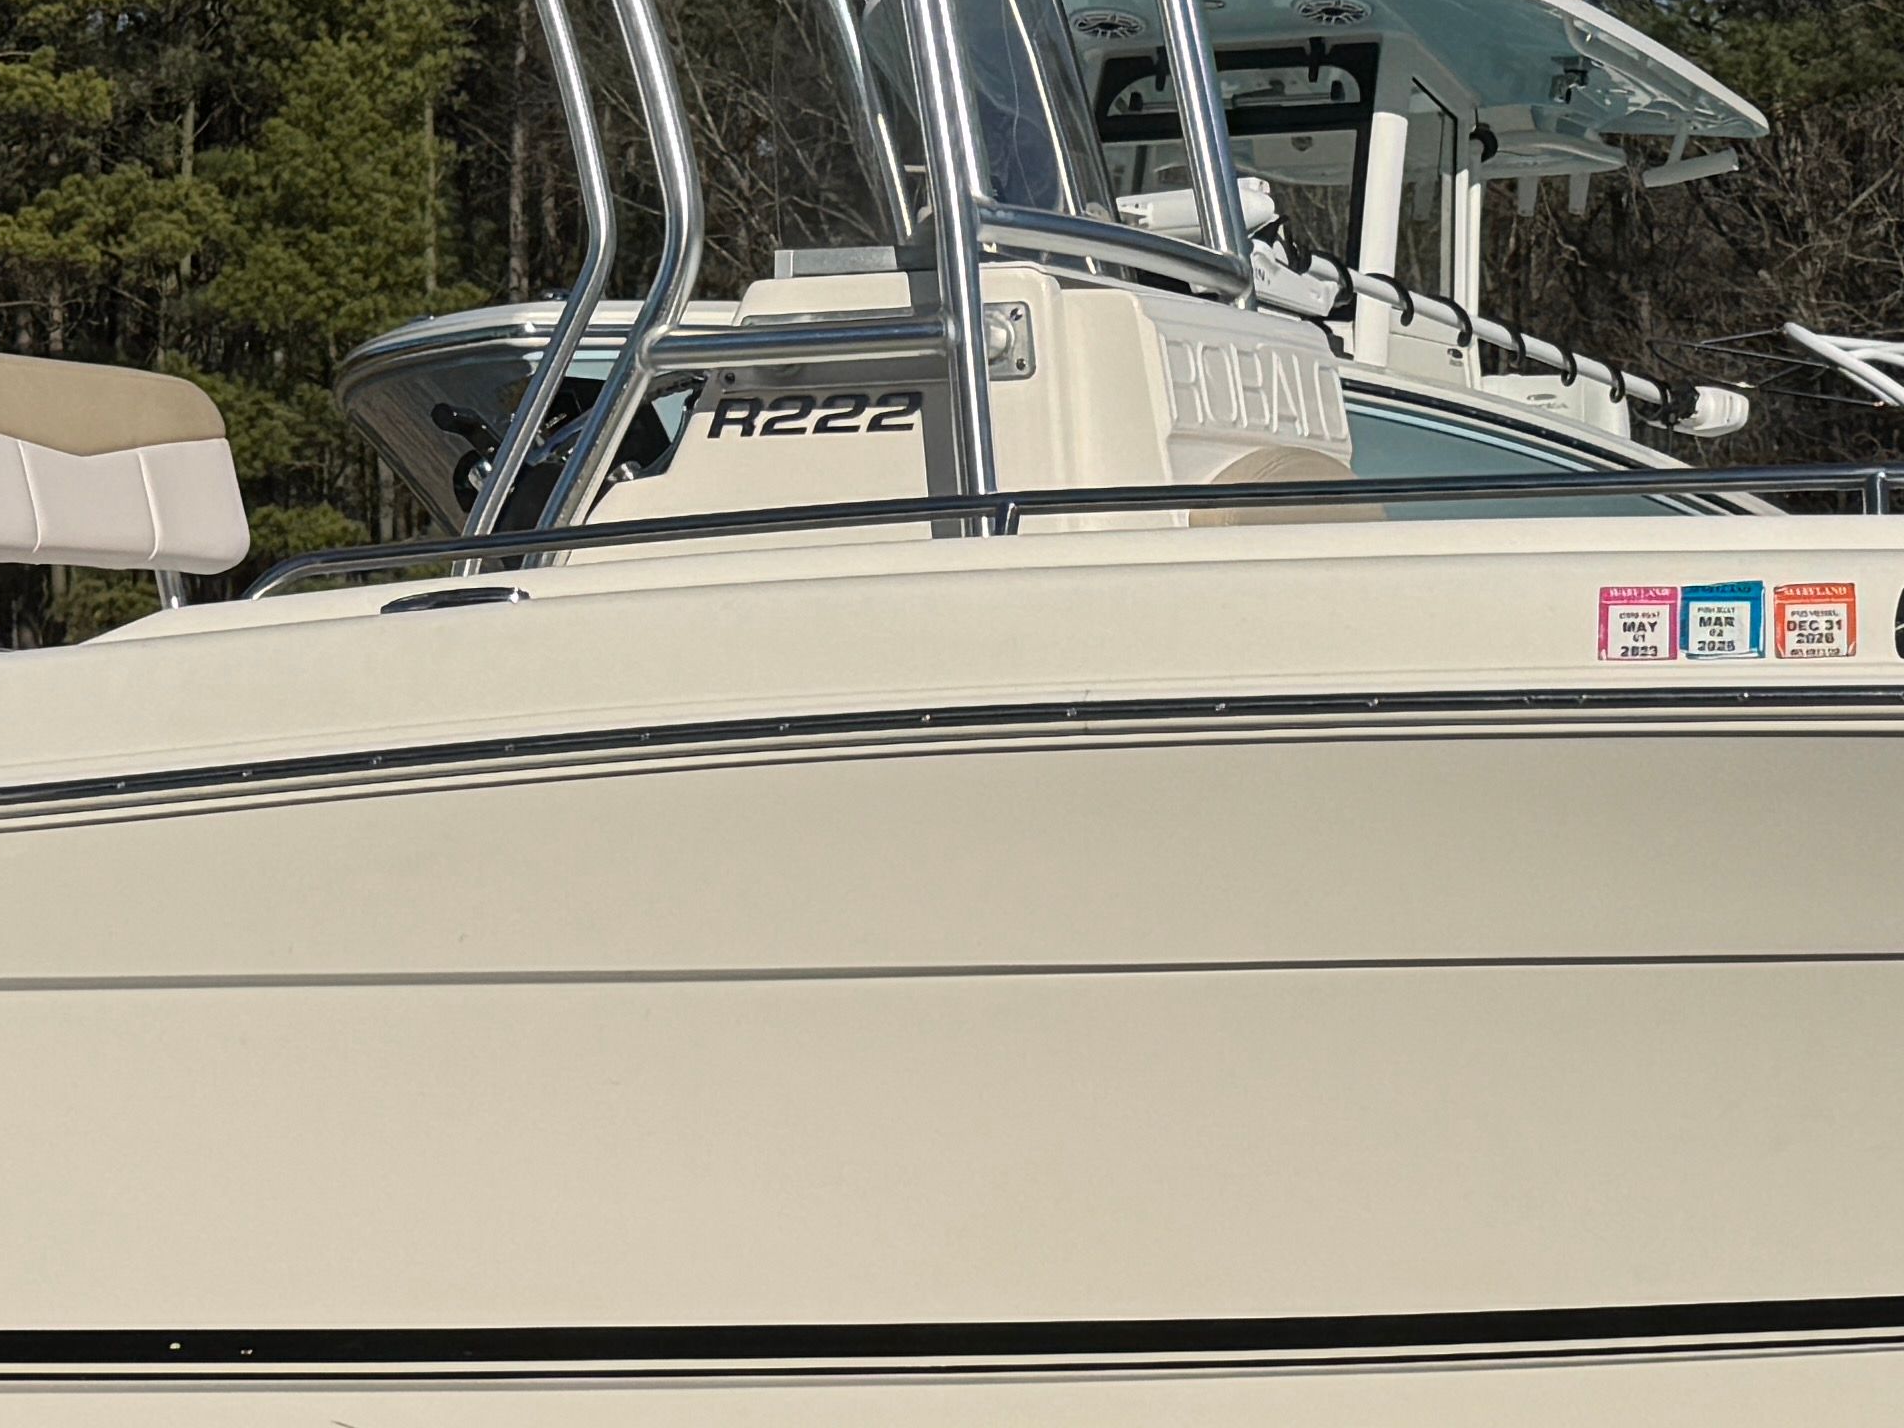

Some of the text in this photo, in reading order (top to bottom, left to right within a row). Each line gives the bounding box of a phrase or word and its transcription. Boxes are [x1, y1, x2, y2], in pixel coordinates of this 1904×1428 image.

[707, 391, 924, 439] R222
[1622, 620, 1658, 633] MAY
[1786, 619, 1842, 632] DEC 31
